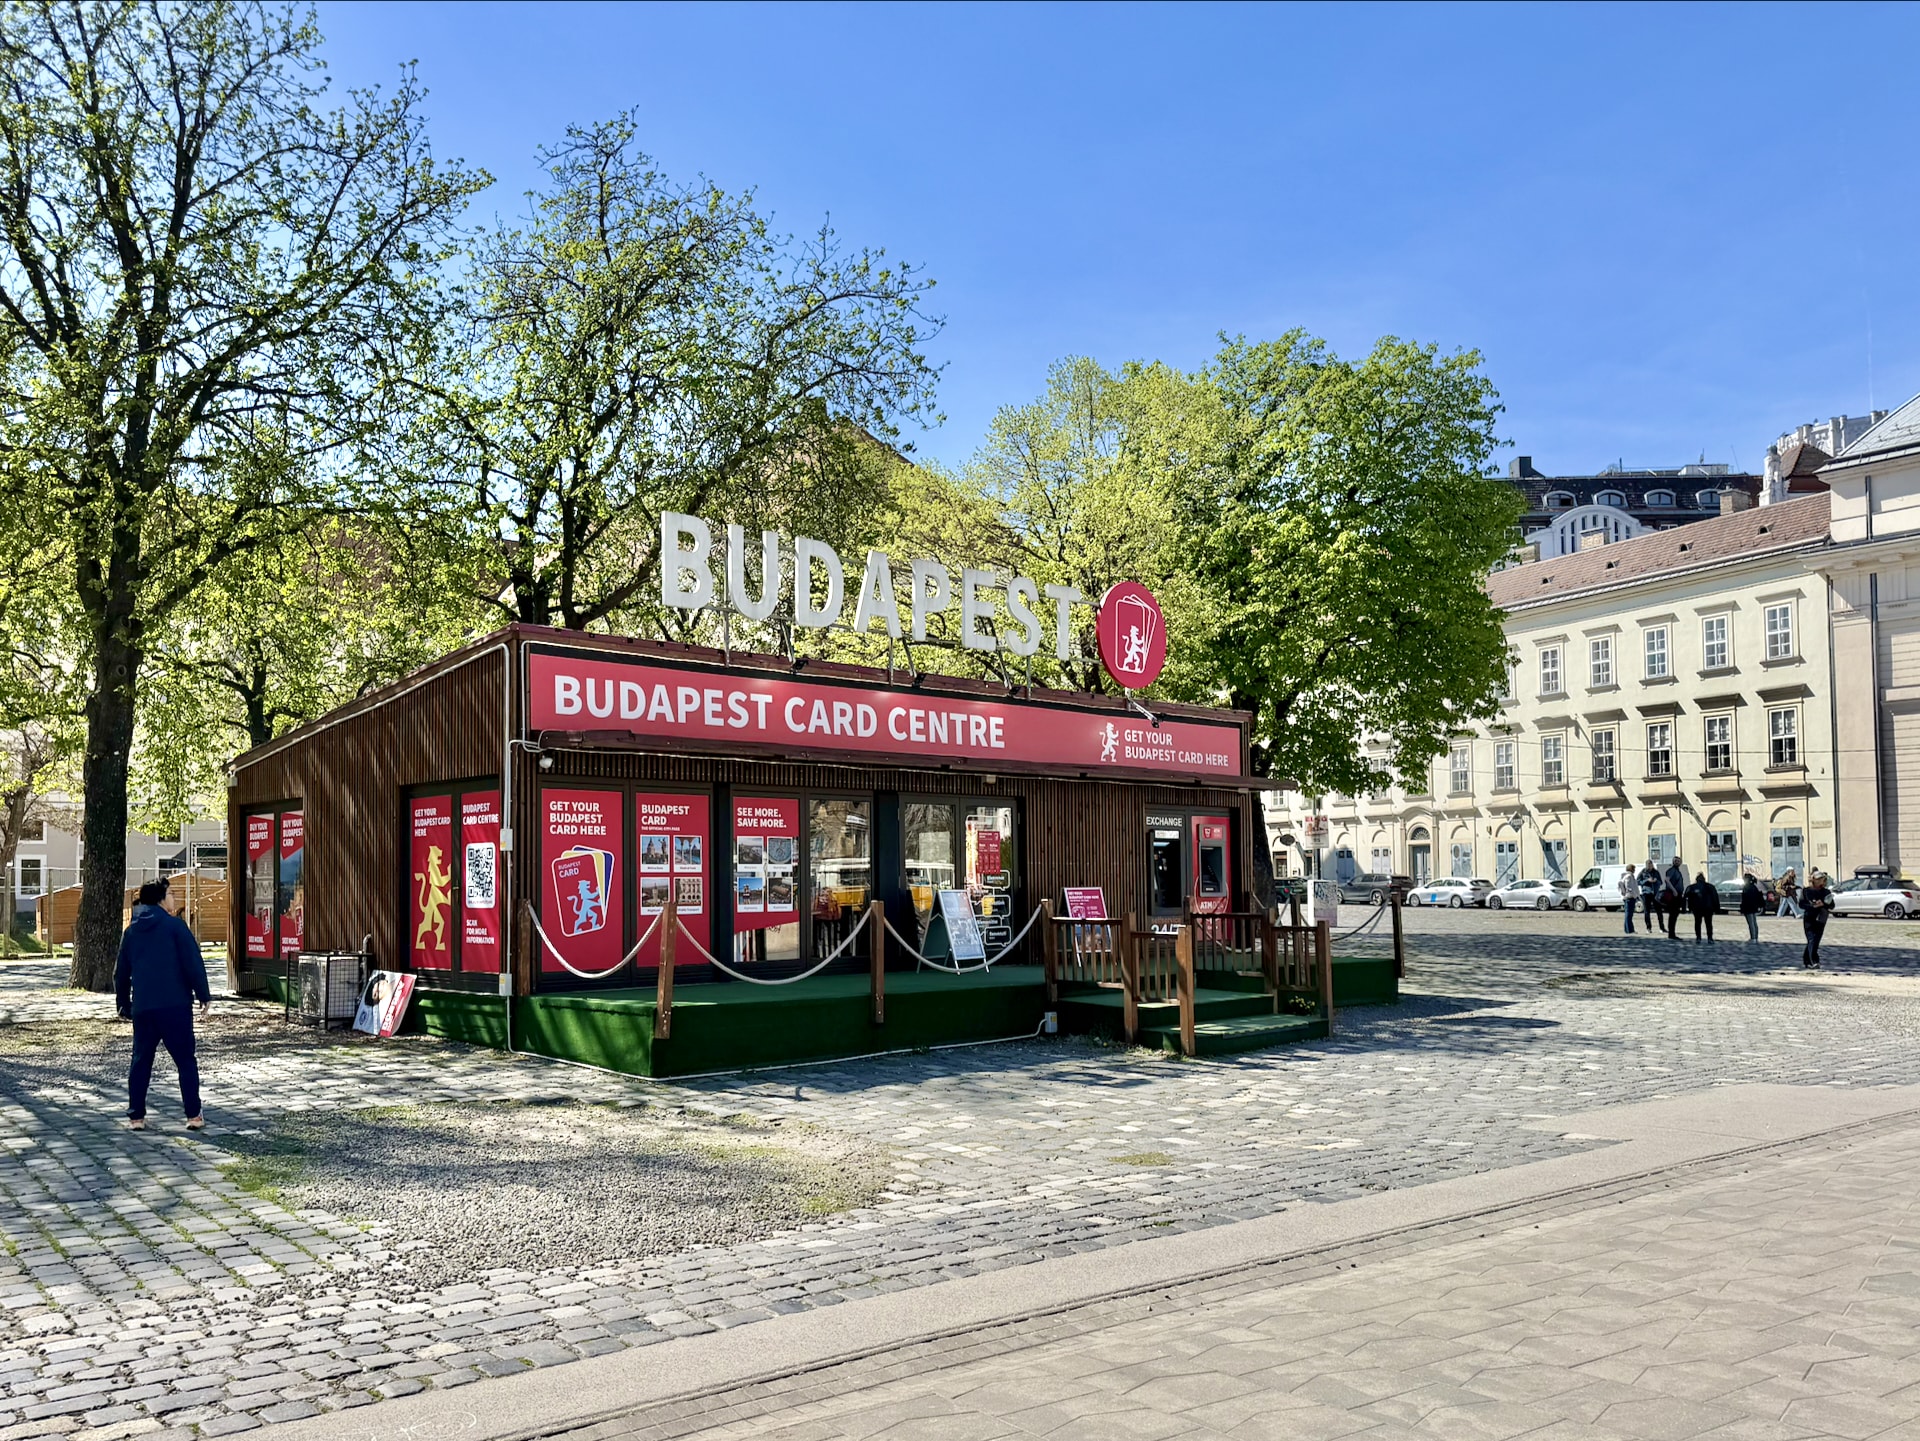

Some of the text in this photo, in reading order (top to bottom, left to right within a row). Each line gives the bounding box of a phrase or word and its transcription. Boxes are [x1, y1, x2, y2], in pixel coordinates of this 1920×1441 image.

[661, 511, 1080, 661] BUDAPEST
[554, 675, 1005, 748] BUDAPEST CARD CENTRE
[1124, 729, 1173, 746] GET YOUR
[1125, 746, 1229, 767] BUDAPEST CARD HERE
[463, 803, 491, 814] BUDAPEST
[549, 801, 600, 812] GET YOUR
[641, 804, 690, 815] BUDAPEST
[414, 807, 437, 817] GET YOUR
[737, 807, 782, 818] SEE MORE.
[283, 818, 302, 828] BUY YOUR
[414, 816, 451, 827] BUDAPEST CARD
[462, 813, 499, 825] CARD CENTRE
[549, 813, 603, 824] BUDAPEST
[641, 816, 667, 826] CARD
[737, 818, 787, 828] SAVE MORE.
[1146, 816, 1183, 827] EXCHANGE
[258, 822, 268, 831] YOUR
[549, 825, 607, 836] CARD HERE
[250, 831, 268, 840] BUDAPEST
[283, 828, 303, 837] BUDAPEST
[414, 828, 427, 837] HERE
[249, 841, 260, 850] CARD
[283, 838, 294, 847] CARD
[558, 861, 581, 870] BUDAPEST
[559, 867, 579, 878] CARD
[1200, 901, 1213, 910] ATM
[466, 919, 478, 927] SCAN
[475, 928, 487, 936] MORE
[466, 936, 495, 945] INFORMATION
